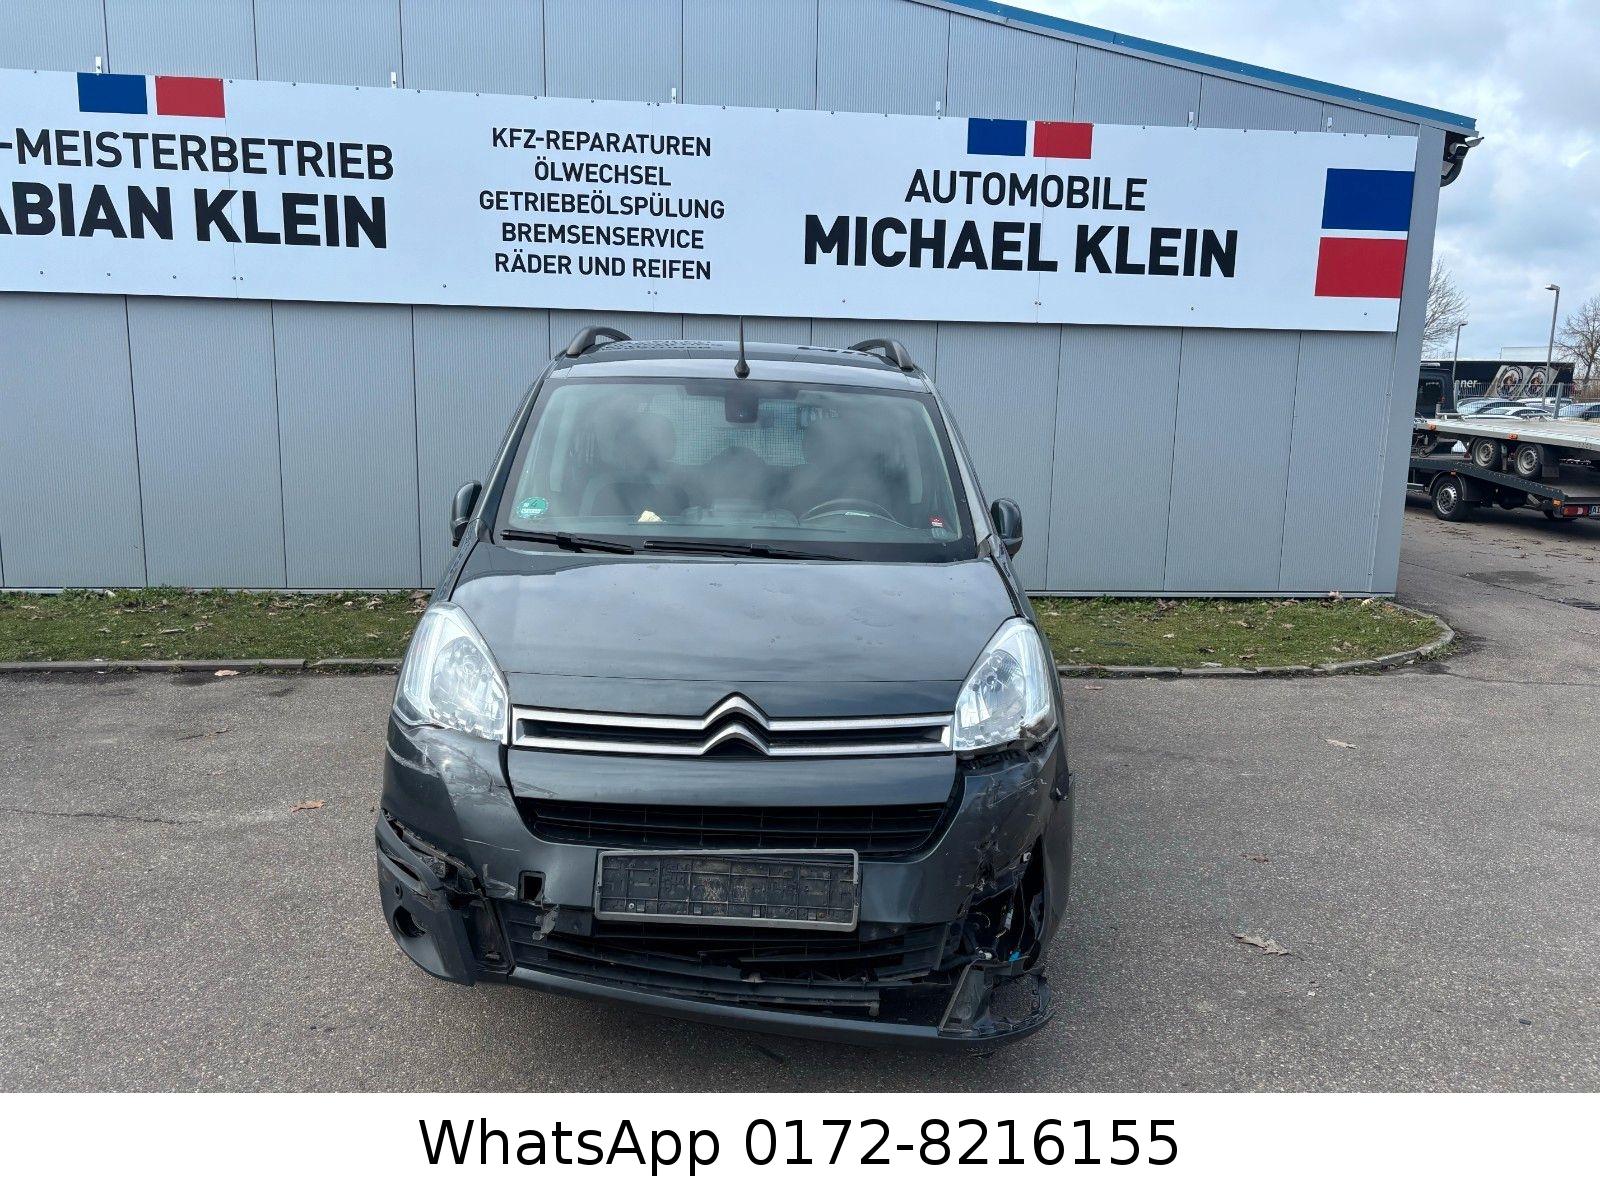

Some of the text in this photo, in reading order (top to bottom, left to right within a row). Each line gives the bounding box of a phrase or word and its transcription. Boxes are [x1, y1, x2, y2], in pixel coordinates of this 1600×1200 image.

[492, 127, 711, 157] KFZ-REPARATUREN
[534, 155, 672, 187] ÖLWECHSEL
[479, 189, 725, 220] GETRIEBEÖLSPÜLUNG
[904, 168, 1148, 212] AUTOMOBILE
[0, 181, 388, 249] BIAN KLEIN
[502, 222, 704, 250] BREMSENSERVICE
[804, 214, 1238, 278] MICHAEL KLEIN
[494, 248, 711, 280] RÄDER UND REIFEN
